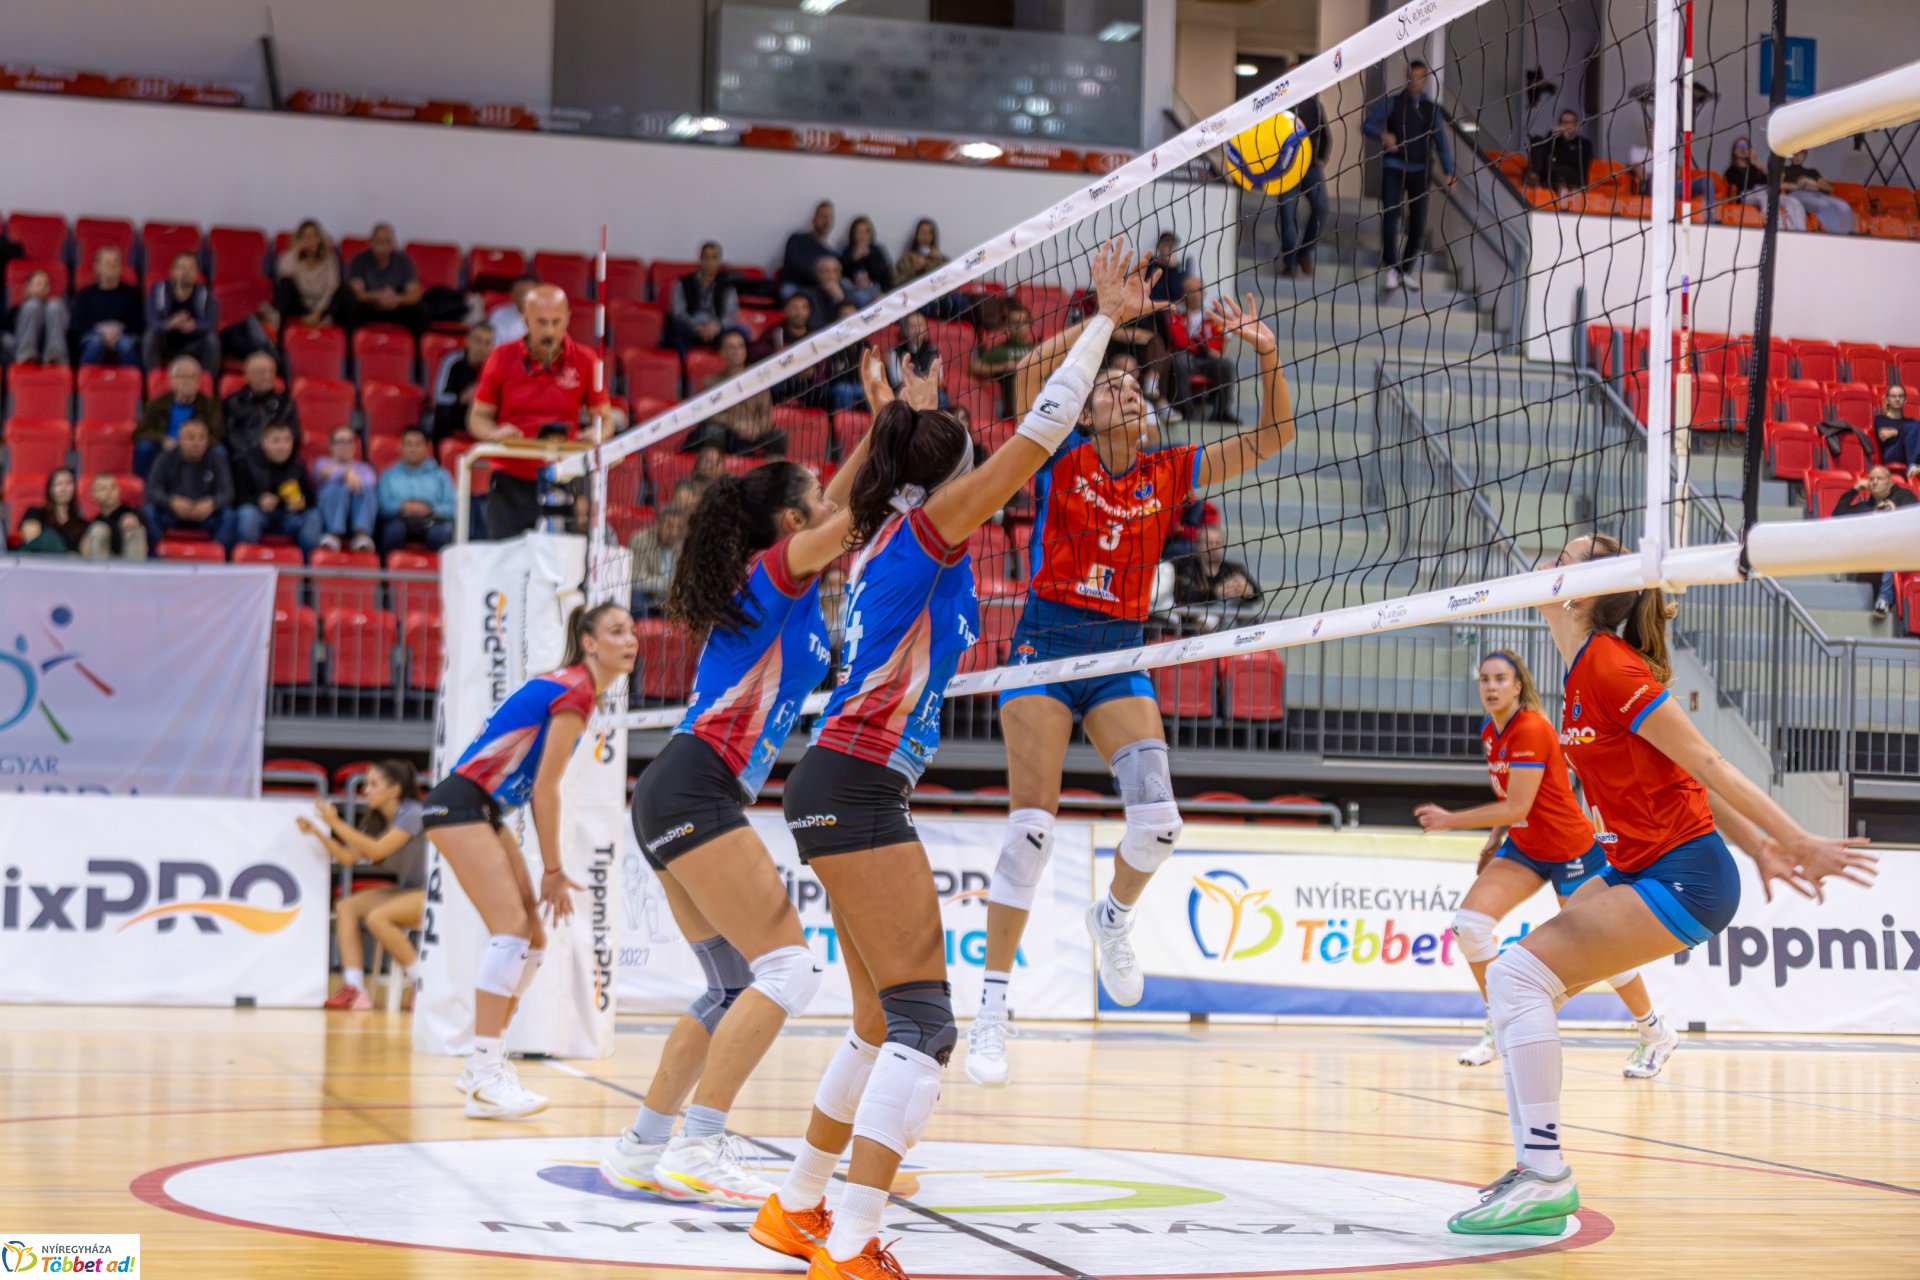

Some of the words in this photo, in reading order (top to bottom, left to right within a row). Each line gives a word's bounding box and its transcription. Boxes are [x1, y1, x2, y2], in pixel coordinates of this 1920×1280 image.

[1099, 519, 1124, 551] 3
[1448, 589, 1489, 611] TippmixPRO
[588, 843, 615, 1013] TippmixPRO
[1296, 919, 1455, 966] Többet
